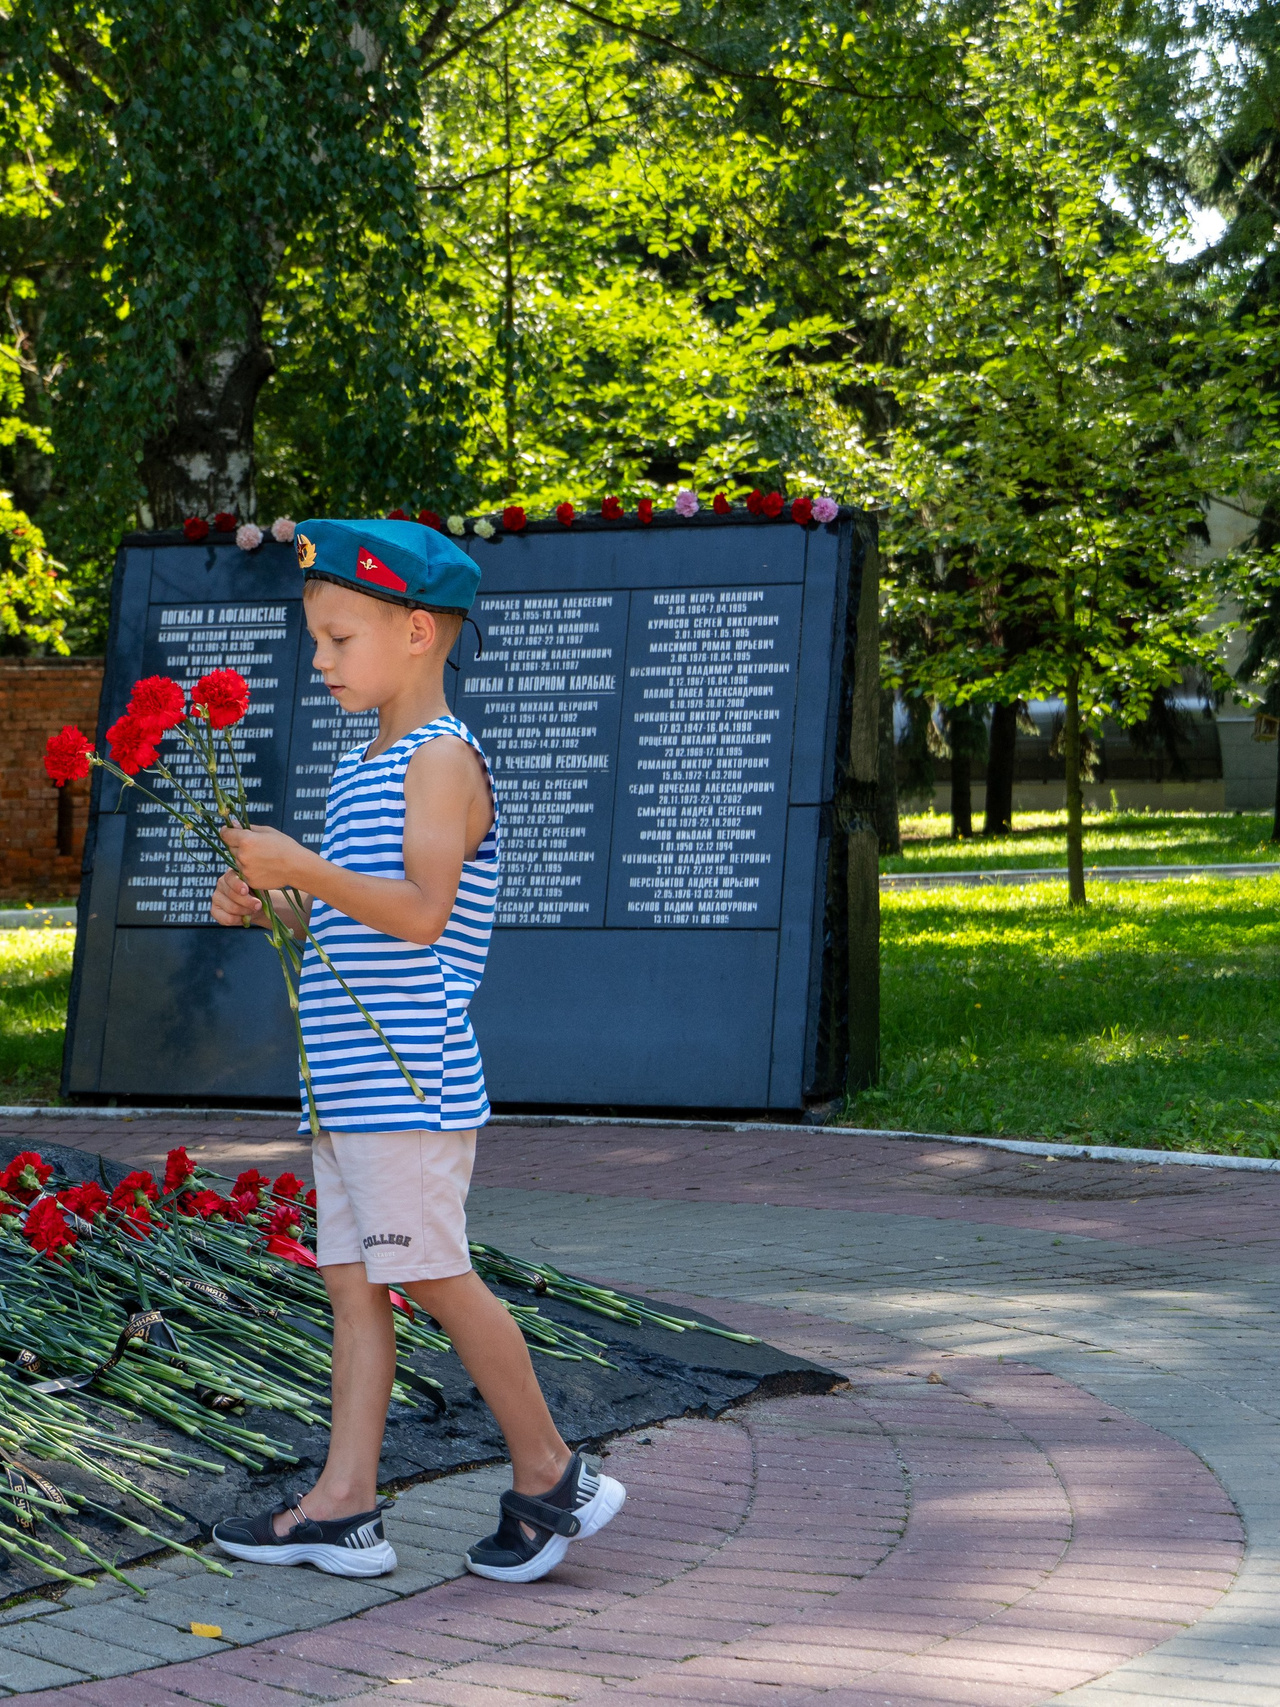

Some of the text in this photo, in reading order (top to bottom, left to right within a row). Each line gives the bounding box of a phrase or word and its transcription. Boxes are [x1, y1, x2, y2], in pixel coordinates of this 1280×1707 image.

[524, 599, 558, 609] МИХАИЛ
[563, 597, 612, 607] АЛЕКСЕЕВИЧ
[654, 591, 764, 605] КОЗЛОВ ИГОРЬ ИВАНОВИЧ
[161, 607, 287, 624] ПОГИБЛИ В АФГАНИСТАНЕ
[648, 615, 779, 629] КУРНОСОВ СЕРГЕЙ ВИКТОРОВИЧ
[530, 624, 553, 635] ОЛЬГА
[558, 623, 599, 633] ИВАНОВНА
[650, 640, 774, 653] МАКСИМОВ РОМАН ЮРЬЕВИЧ
[513, 649, 547, 660] ЕВГЕНИЙ
[551, 648, 612, 659] ВАЛЕНТИНОВИЧ
[687, 664, 732, 677] ВЛАДИМИР
[738, 663, 789, 674] ВИКТОРОВИЧ
[465, 675, 616, 693] ПОГИБЛИ В НАГОРНОМ КАРАБАХЕ
[644, 686, 773, 699] ПАВЛОВ ПАВЕЛ АЛЕКСАНДРОВИЧ
[520, 702, 554, 712] МИХАИЛ
[634, 709, 779, 722] ПРОКОПЕНКО ВИКТОР ГРИГОРЬЕВИЧ
[517, 728, 540, 738] ИГОРЬ
[545, 727, 597, 737] НИКОЛАЕВИЧ
[639, 733, 771, 747] ПРОЦЕНКО ВИТАЛИЙ НИКОЛАЕВИЧ
[495, 757, 502, 769] В
[506, 754, 551, 769] ЧЕЧЕНСКОЙ
[556, 754, 609, 768] РЕСПУБЛИКЕ
[638, 758, 769, 770] РОМАНОВ ВИКТОР ВИКТОРОВИЧ
[629, 782, 774, 795] СЕДОВ ВЯЧЕСЛАВ АЛЕКСАНДРОВИЧ
[503, 803, 594, 815] РОМАН АЛЕКСАНДРОВИЧ
[681, 805, 713, 818] АНДРЕЙ
[718, 805, 762, 816] СЕРГЕЕВИЧ
[640, 828, 756, 841] ФРОЛОВ НИКОЛАЙ ПЕТРОВИЧ
[543, 852, 594, 862] НИКОЛАЕВИЧ
[678, 853, 725, 865] ВЛАДИМИР
[730, 853, 771, 864] ПЕТРОВИЧ
[630, 876, 759, 889] ШЕРСТОБИТОВ АНДРЕЙ ЮРЬЕВИЧ
[170, 901, 195, 911] СЕРГЕЙ
[539, 901, 589, 912] ВИКТОРОВИЧ
[628, 902, 758, 913] ЮСУПОВ ВАДИМ МАГАФУРОВИЧ
[363, 1234, 412, 1249] COLLEGE
[194, 1283, 228, 1300] ПАМЯТЬ
[124, 1314, 159, 1338] ВЕЧНАЯ
